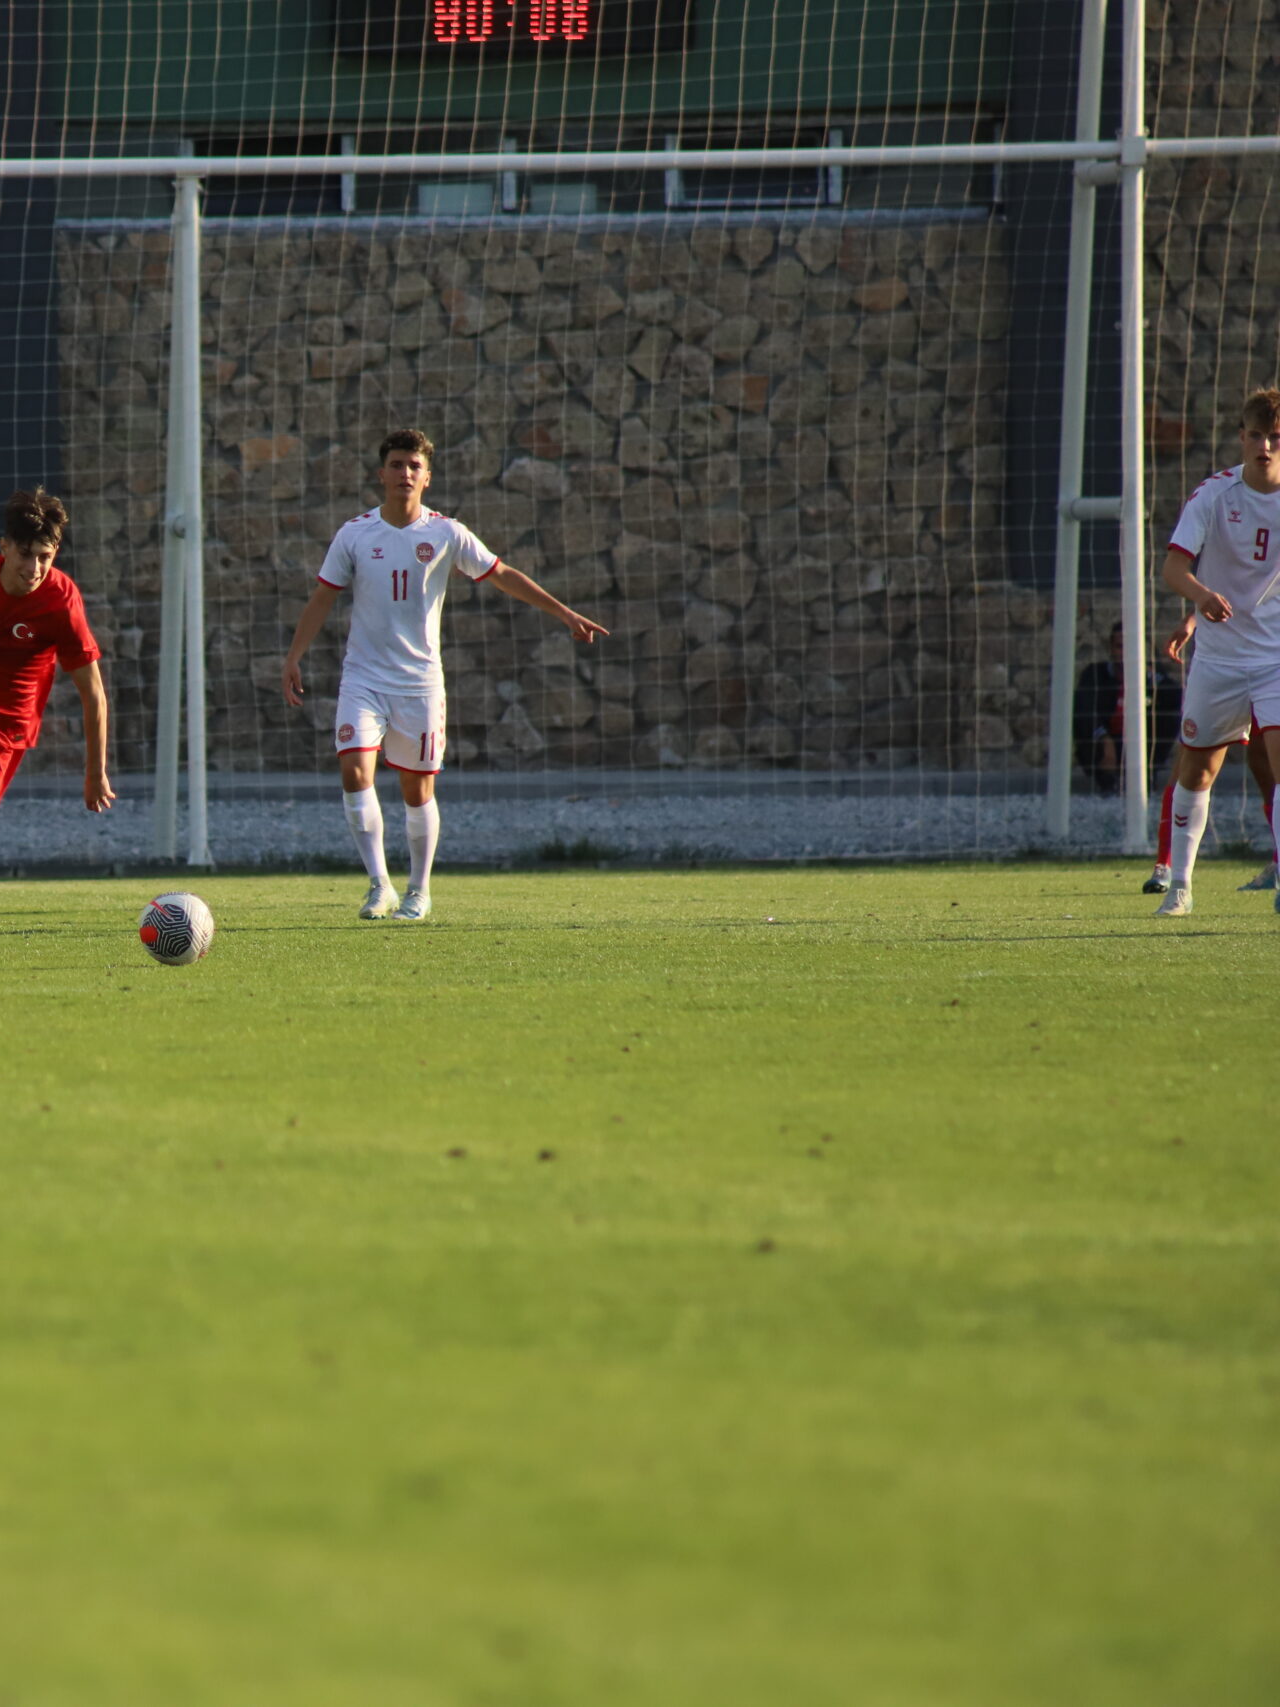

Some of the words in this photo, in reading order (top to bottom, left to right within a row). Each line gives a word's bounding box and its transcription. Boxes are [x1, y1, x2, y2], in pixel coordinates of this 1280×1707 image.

[1253, 527, 1269, 561] 9
[391, 569, 408, 601] 11
[419, 731, 435, 762] 11
